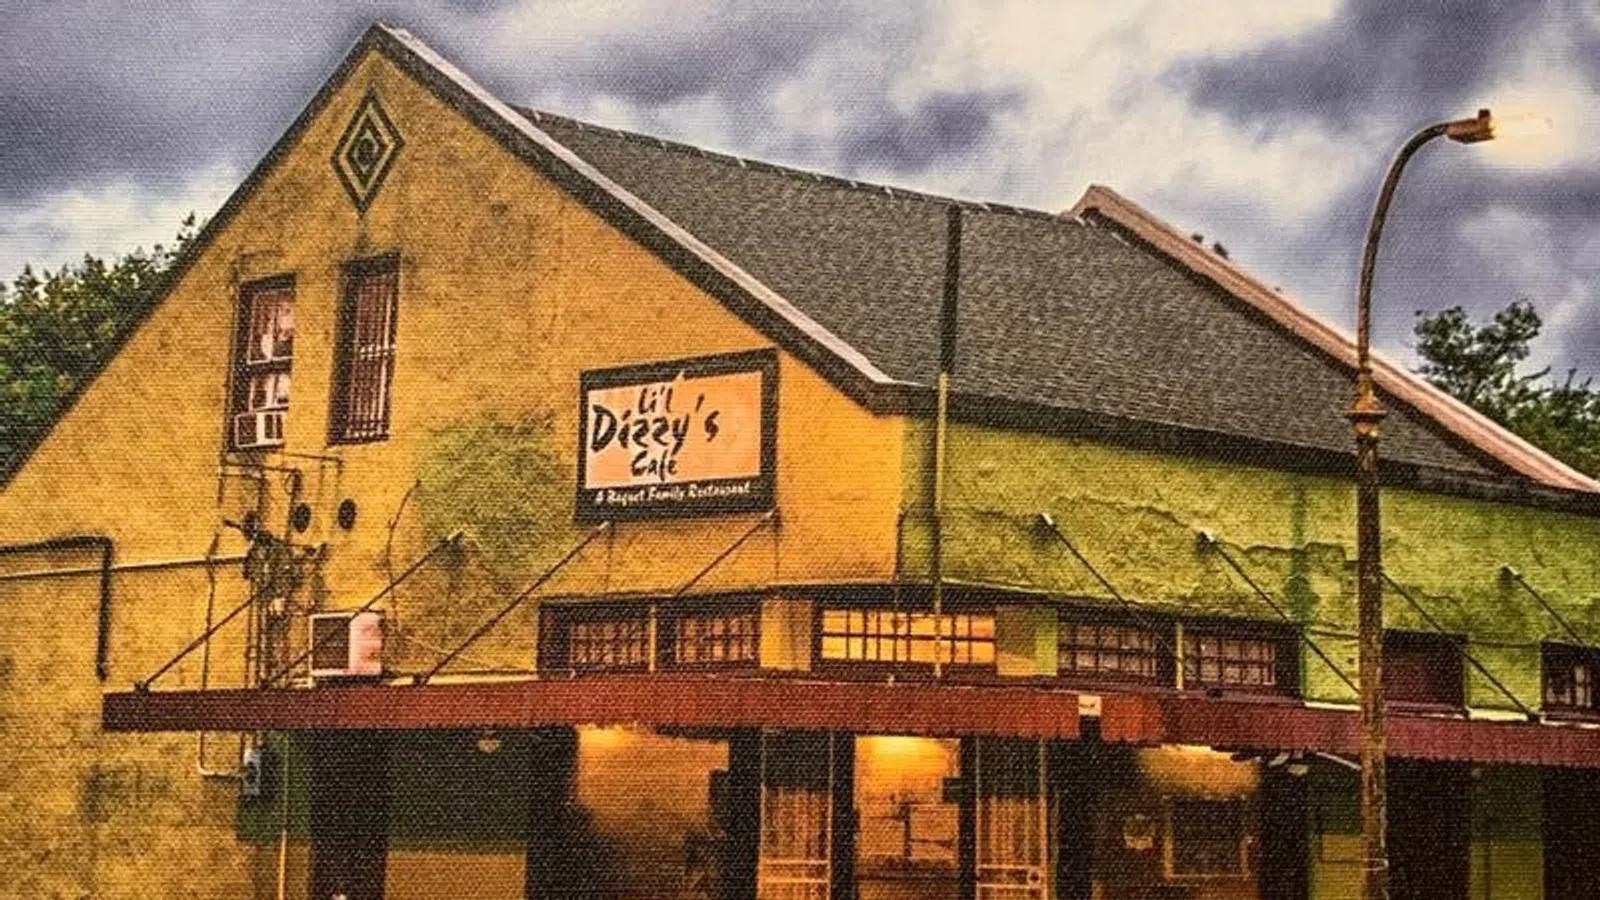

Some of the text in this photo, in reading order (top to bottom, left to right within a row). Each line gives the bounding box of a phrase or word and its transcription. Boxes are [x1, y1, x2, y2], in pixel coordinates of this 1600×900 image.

[638, 386, 674, 415] Li'l
[591, 393, 720, 456] Dizzy's
[648, 486, 684, 501] Family
[688, 481, 750, 498] Restaurant
